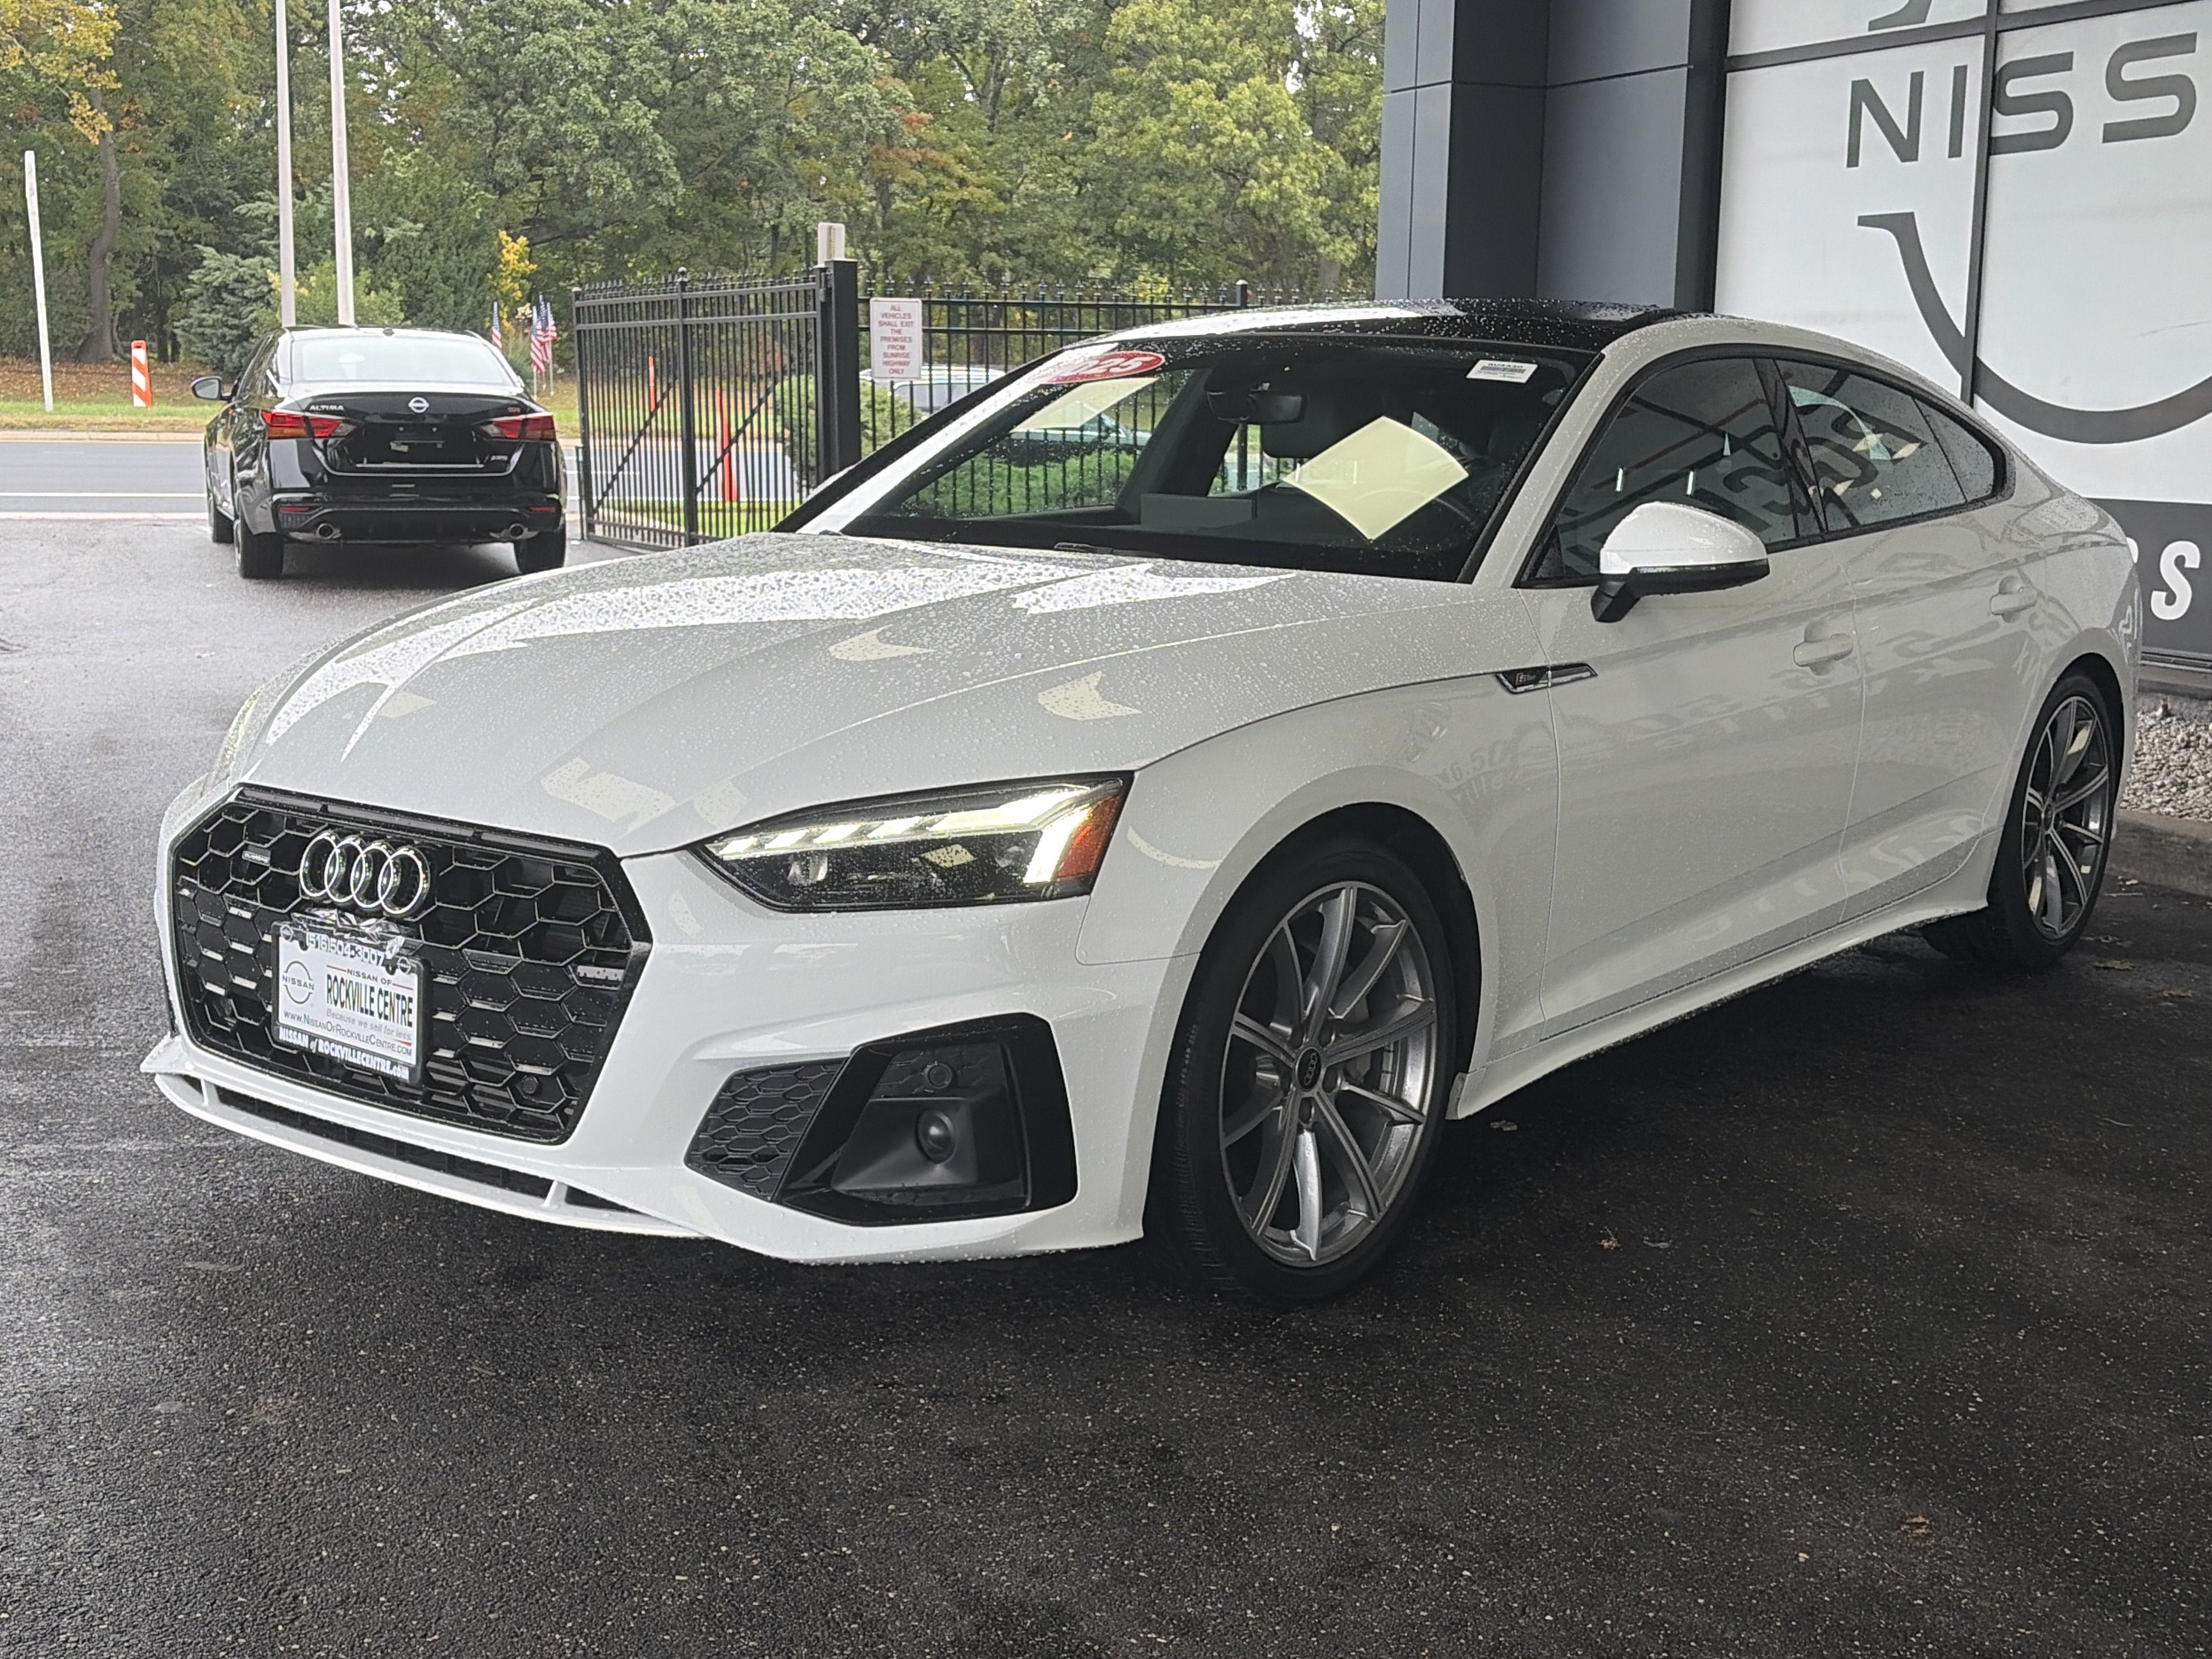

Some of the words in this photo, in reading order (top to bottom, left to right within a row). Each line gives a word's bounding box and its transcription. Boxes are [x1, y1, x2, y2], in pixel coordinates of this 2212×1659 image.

[282, 975, 314, 990] NISSAN
[347, 968, 378, 983] NISSAN
[381, 977, 392, 986] OF
[326, 974, 375, 1017] ROCKVILLE
[377, 988, 414, 1028] CENTRE
[326, 1008, 356, 1025] Because
[358, 1019, 368, 1029] we
[370, 1020, 383, 1034] sell
[384, 1024, 394, 1036] for
[279, 1025, 309, 1048] NISSAN
[309, 1040, 319, 1054] of
